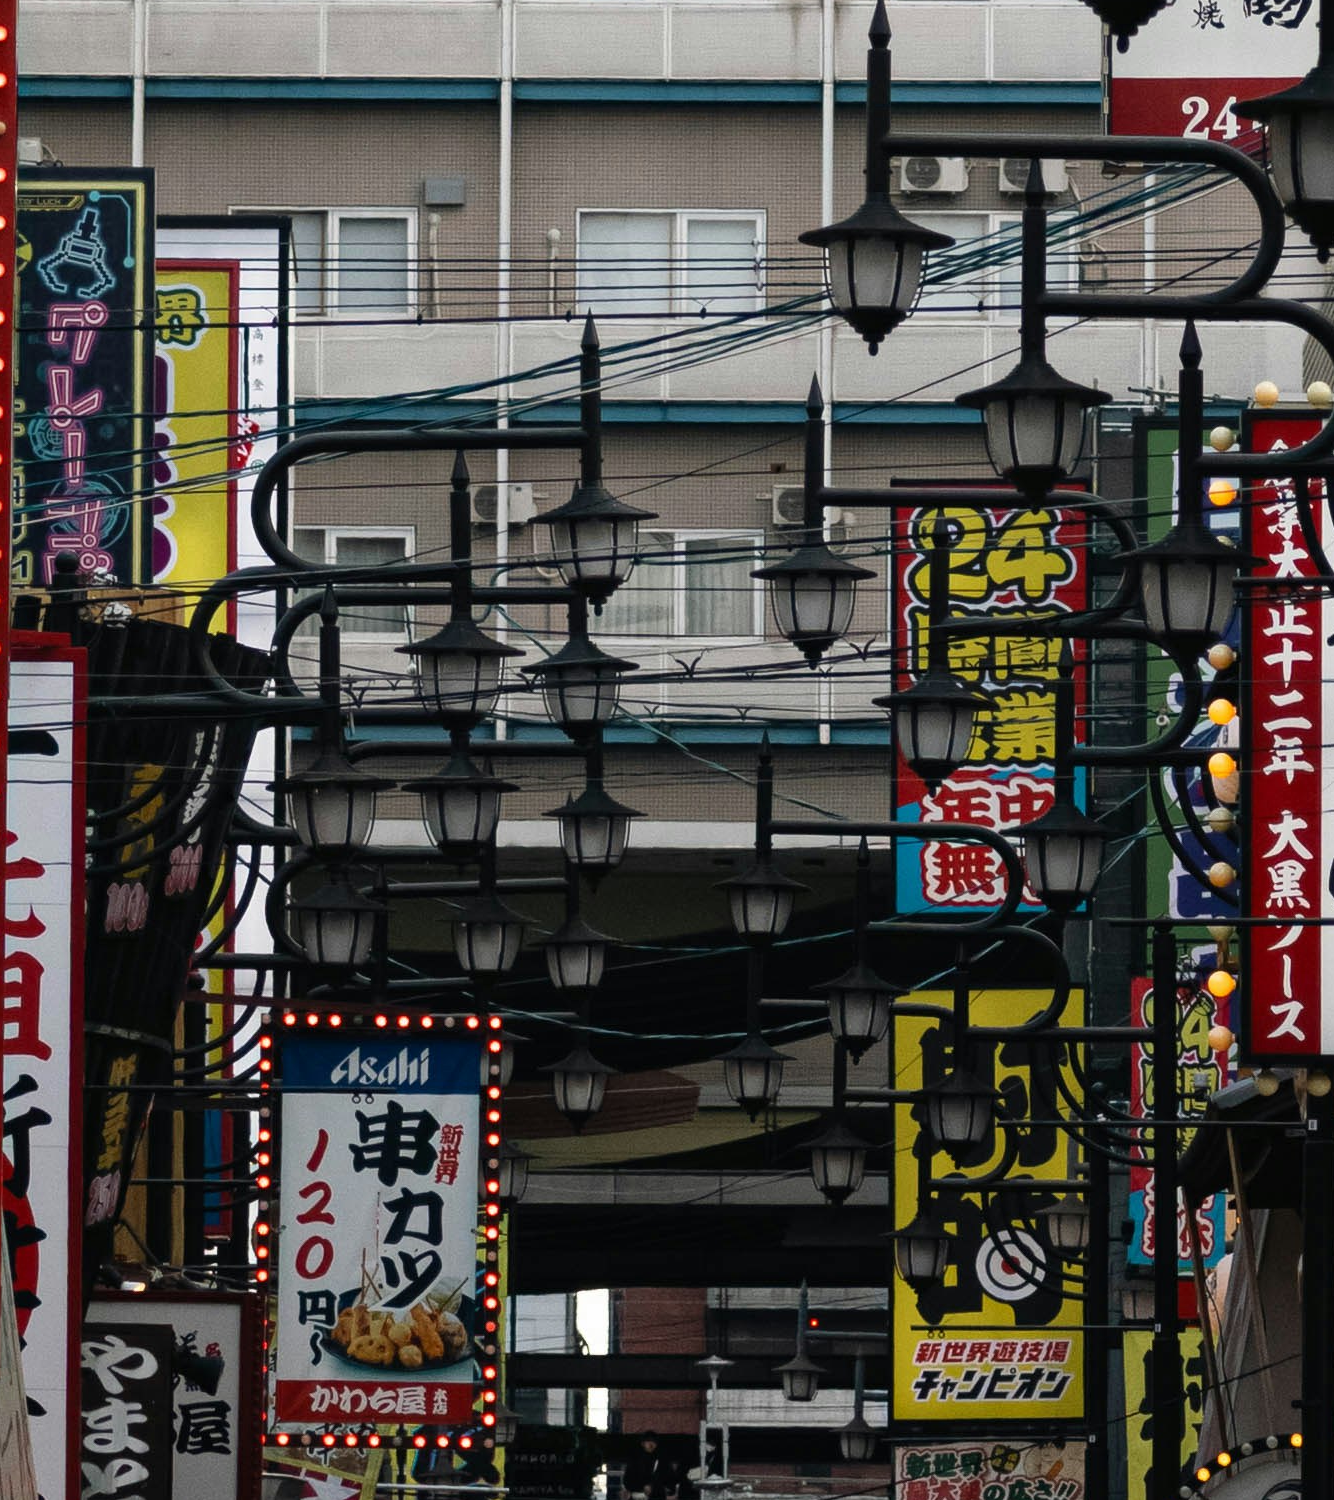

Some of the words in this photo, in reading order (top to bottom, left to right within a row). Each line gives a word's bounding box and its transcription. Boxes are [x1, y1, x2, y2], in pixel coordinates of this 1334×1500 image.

[330, 1046, 430, 1086] Asahi
[349, 1101, 444, 1308] 串カツ
[309, 1384, 427, 1416] かわち屋
[912, 1368, 1072, 1400] チャンピオン
